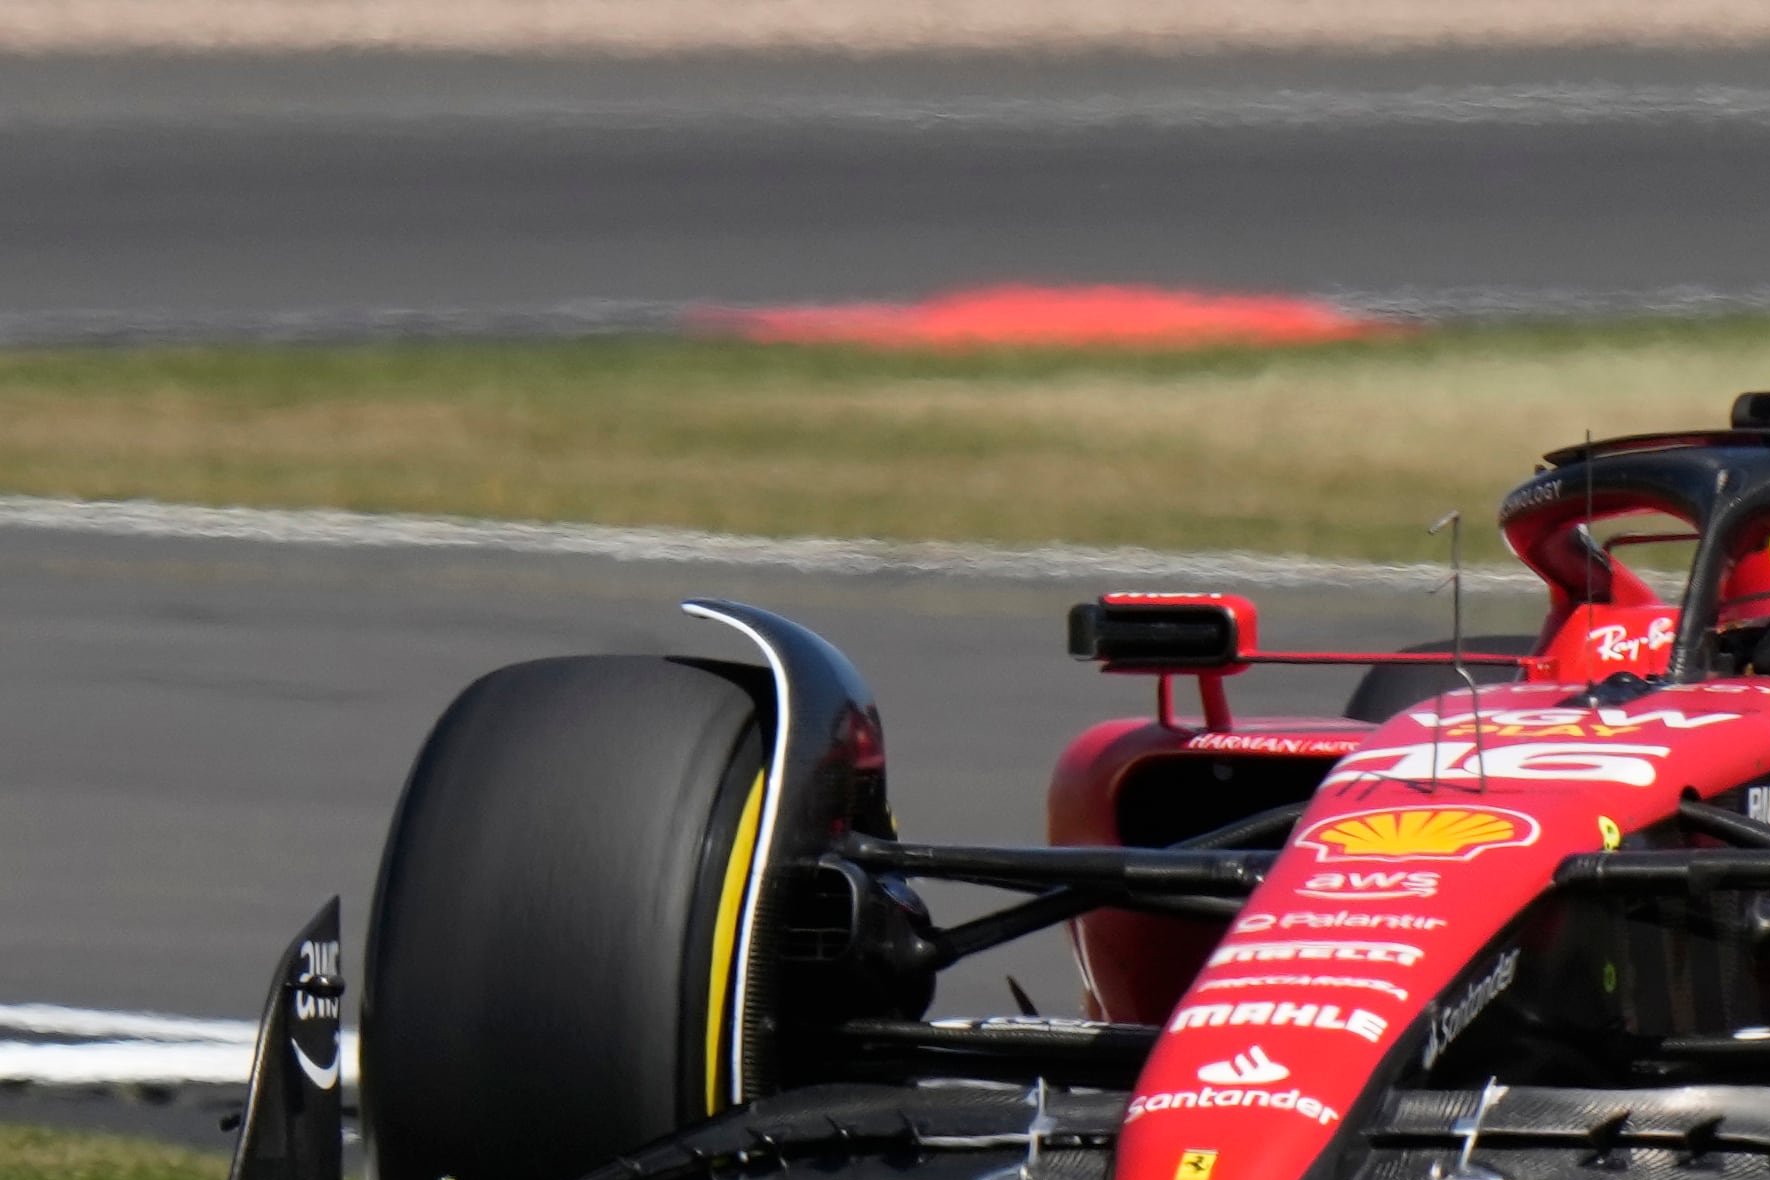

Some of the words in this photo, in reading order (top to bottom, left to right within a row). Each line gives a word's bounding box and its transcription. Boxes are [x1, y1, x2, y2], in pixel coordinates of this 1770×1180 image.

[1408, 707, 1742, 729] VGW
[1446, 723, 1644, 738] PLAY
[1318, 742, 1671, 787] 16
[1303, 871, 1442, 890] aws
[1279, 910, 1448, 931] Palantir
[1207, 939, 1424, 968] PIRELLI
[1439, 948, 1521, 1055] Santander
[1168, 1002, 1388, 1043] MAHLE
[1124, 1086, 1339, 1125] Santander
